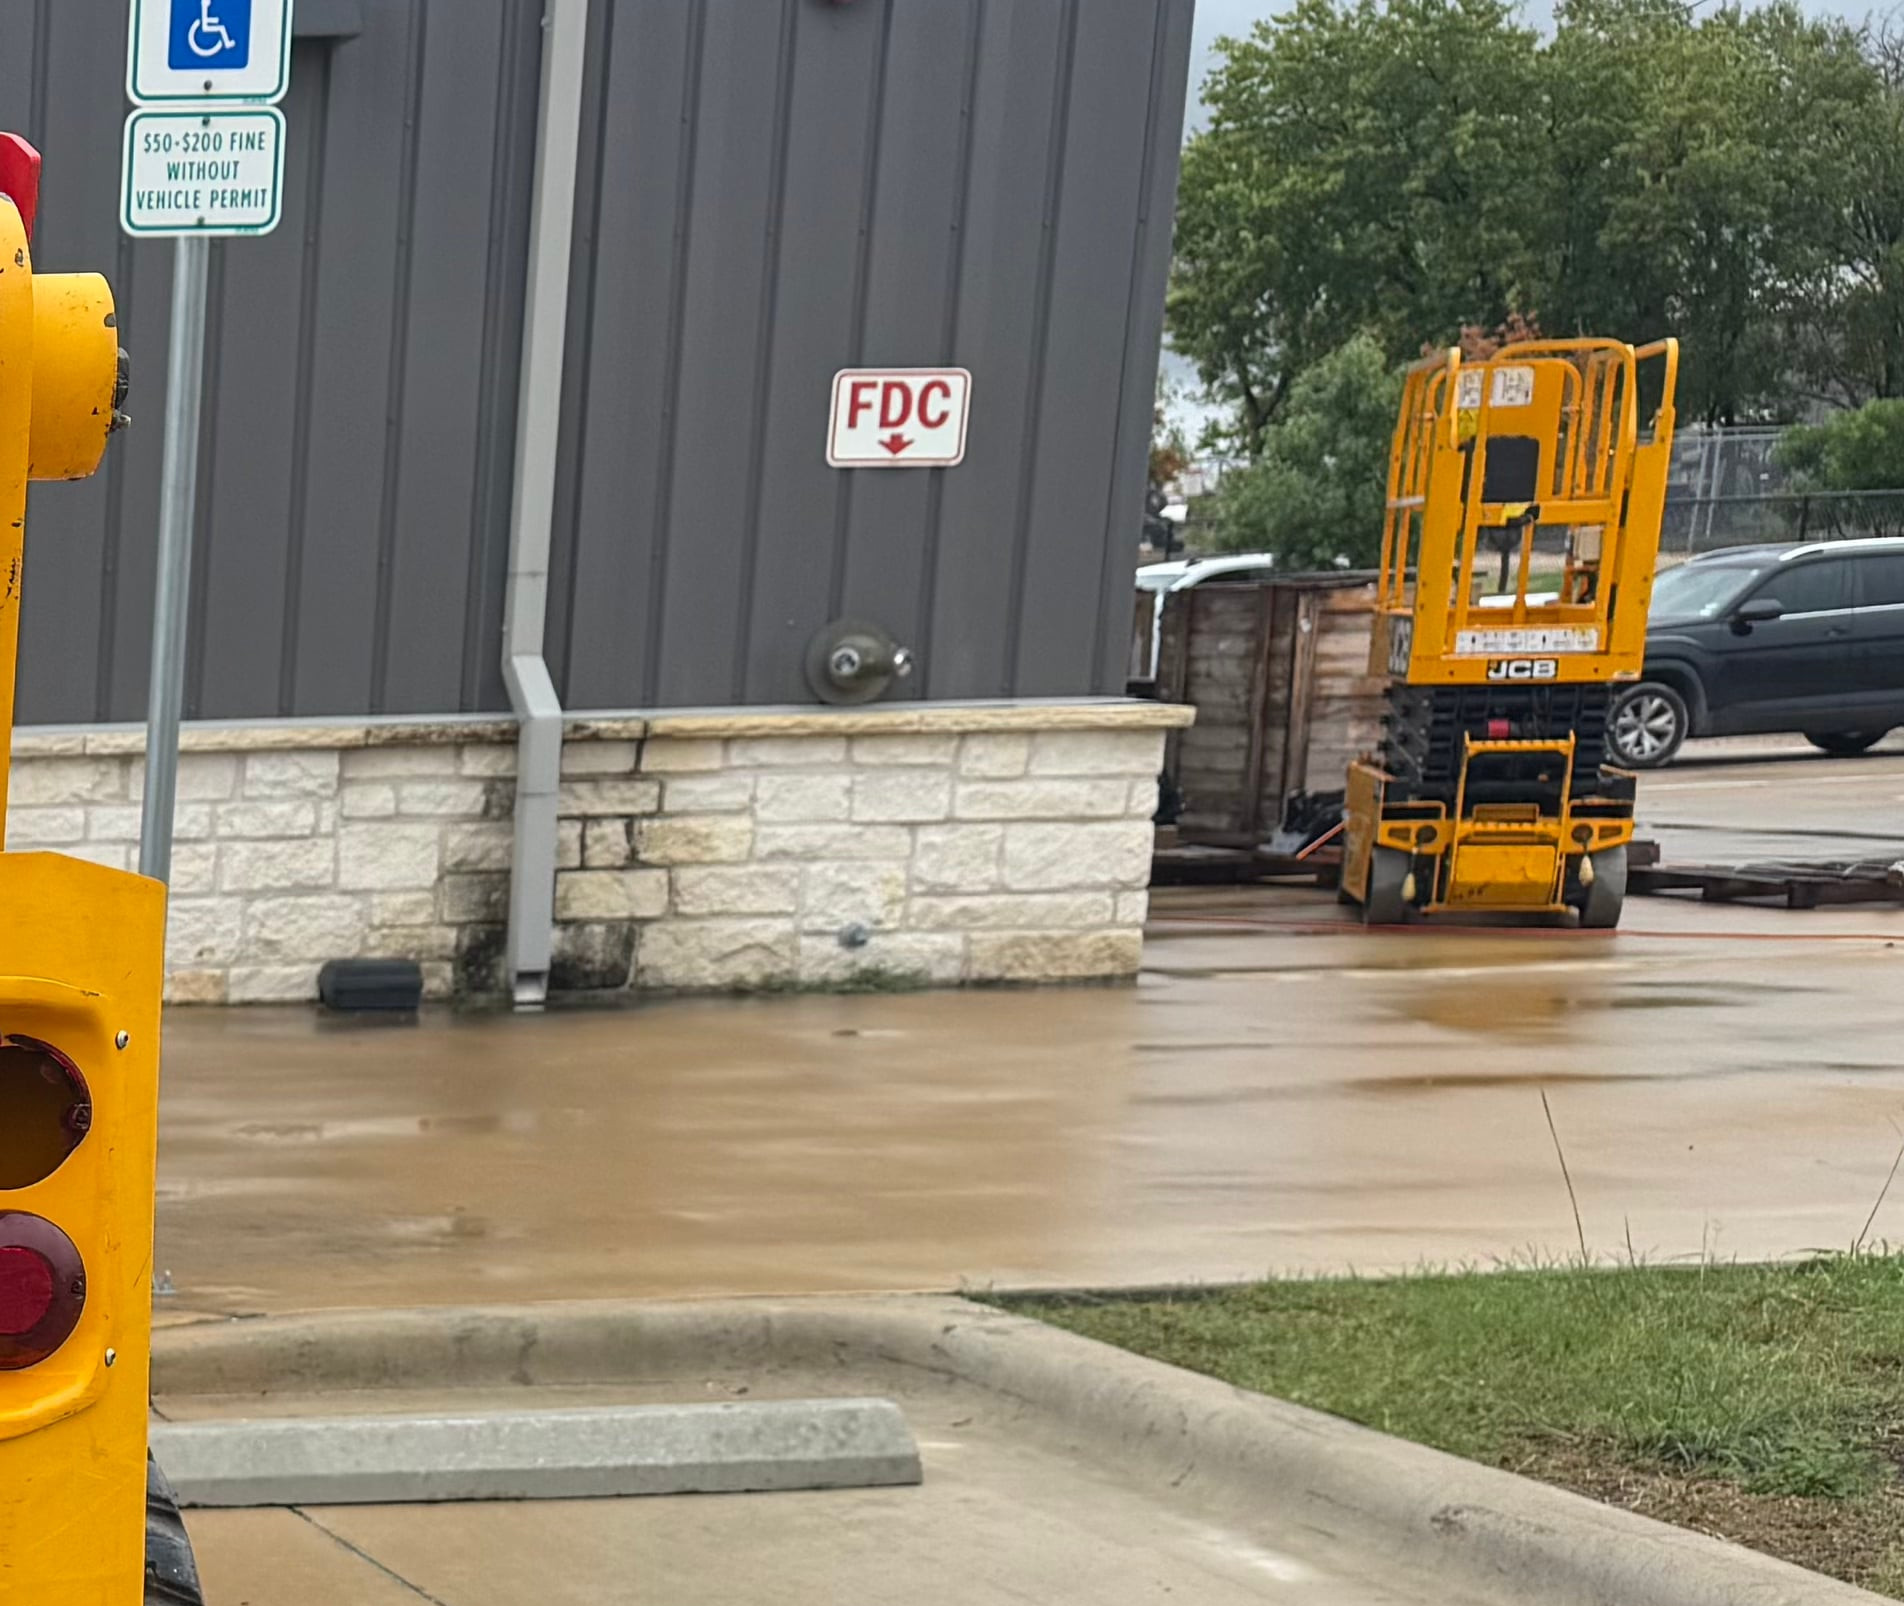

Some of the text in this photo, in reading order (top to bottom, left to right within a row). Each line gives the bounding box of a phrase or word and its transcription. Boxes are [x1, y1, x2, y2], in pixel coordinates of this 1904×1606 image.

[143, 130, 266, 154] $50-$200 FINE
[167, 160, 240, 181] WITHOUT
[136, 188, 268, 210] VEHICLE PERMIT
[847, 379, 951, 430] FDC
[1487, 659, 1556, 679] JCB
